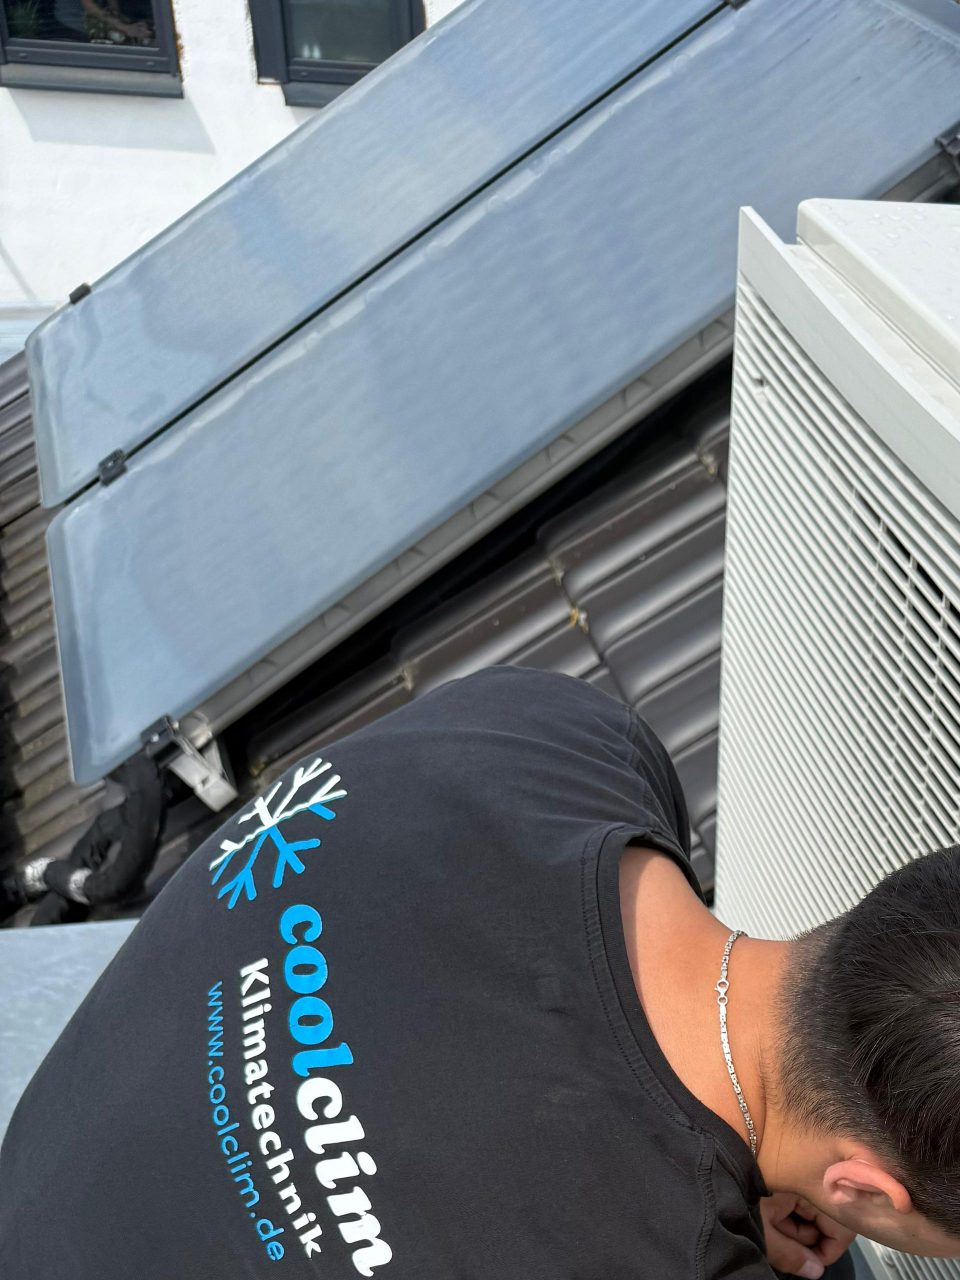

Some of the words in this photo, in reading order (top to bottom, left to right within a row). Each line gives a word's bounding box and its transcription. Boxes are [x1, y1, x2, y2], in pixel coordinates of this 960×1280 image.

[207, 980, 286, 1261] www.coolclim.de
[240, 957, 324, 1259] Klimatechnik
[279, 903, 394, 1278] coolclim
